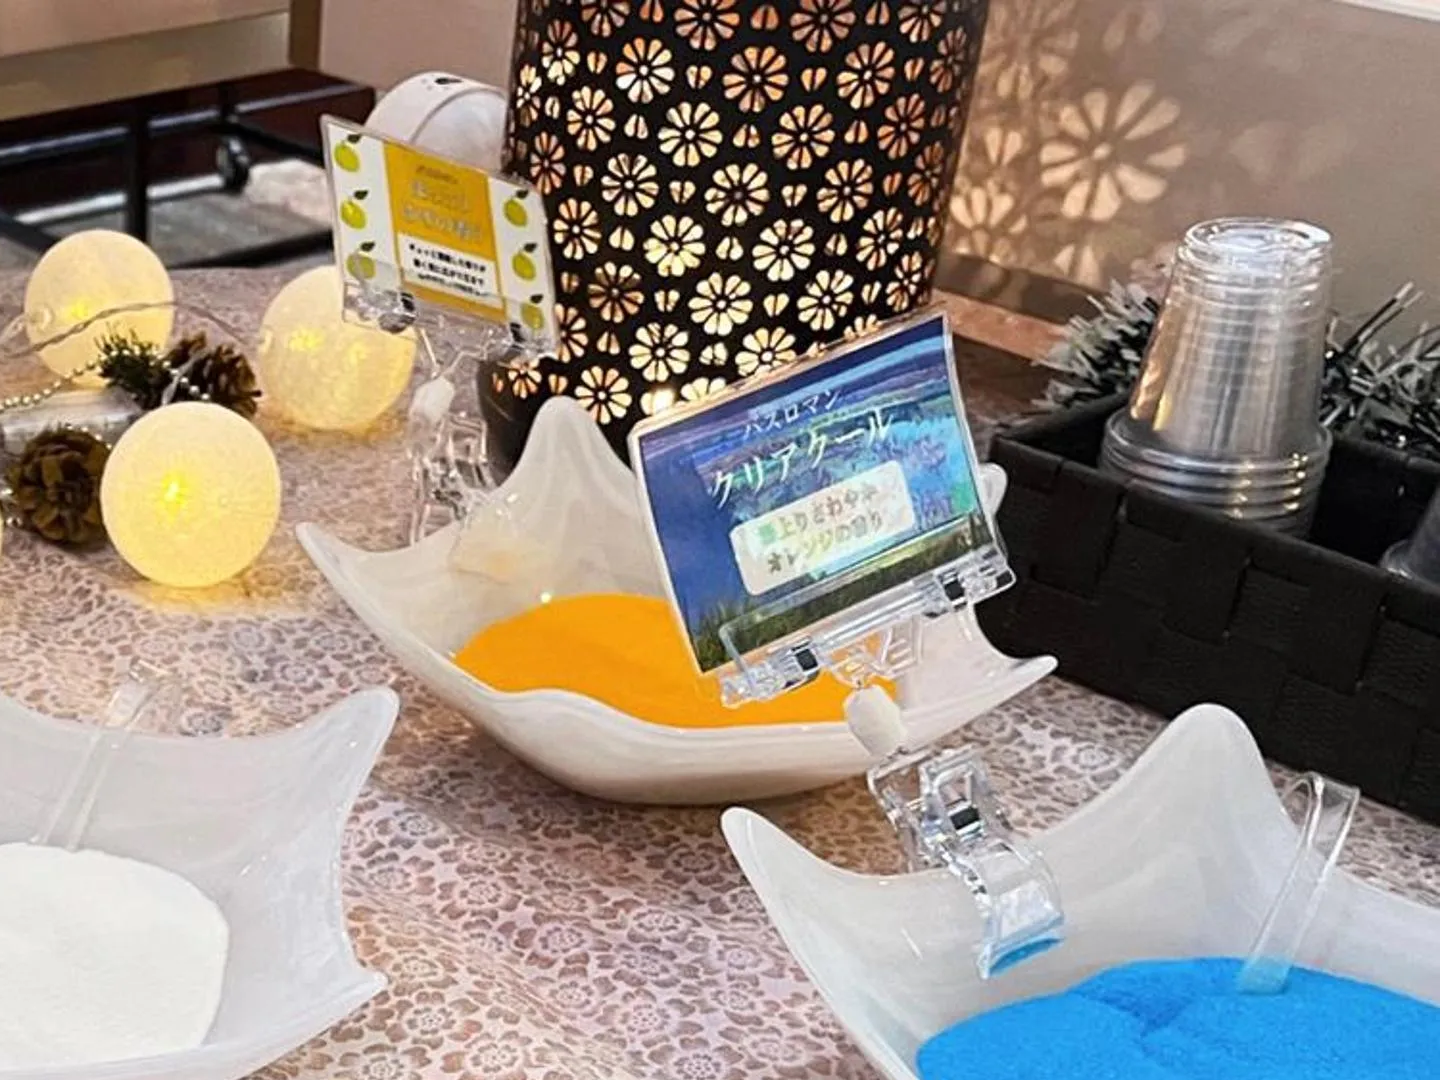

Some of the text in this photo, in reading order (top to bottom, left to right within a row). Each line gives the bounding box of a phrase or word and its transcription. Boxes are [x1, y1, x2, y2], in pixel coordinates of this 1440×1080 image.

[708, 410, 894, 509] クリアクール
